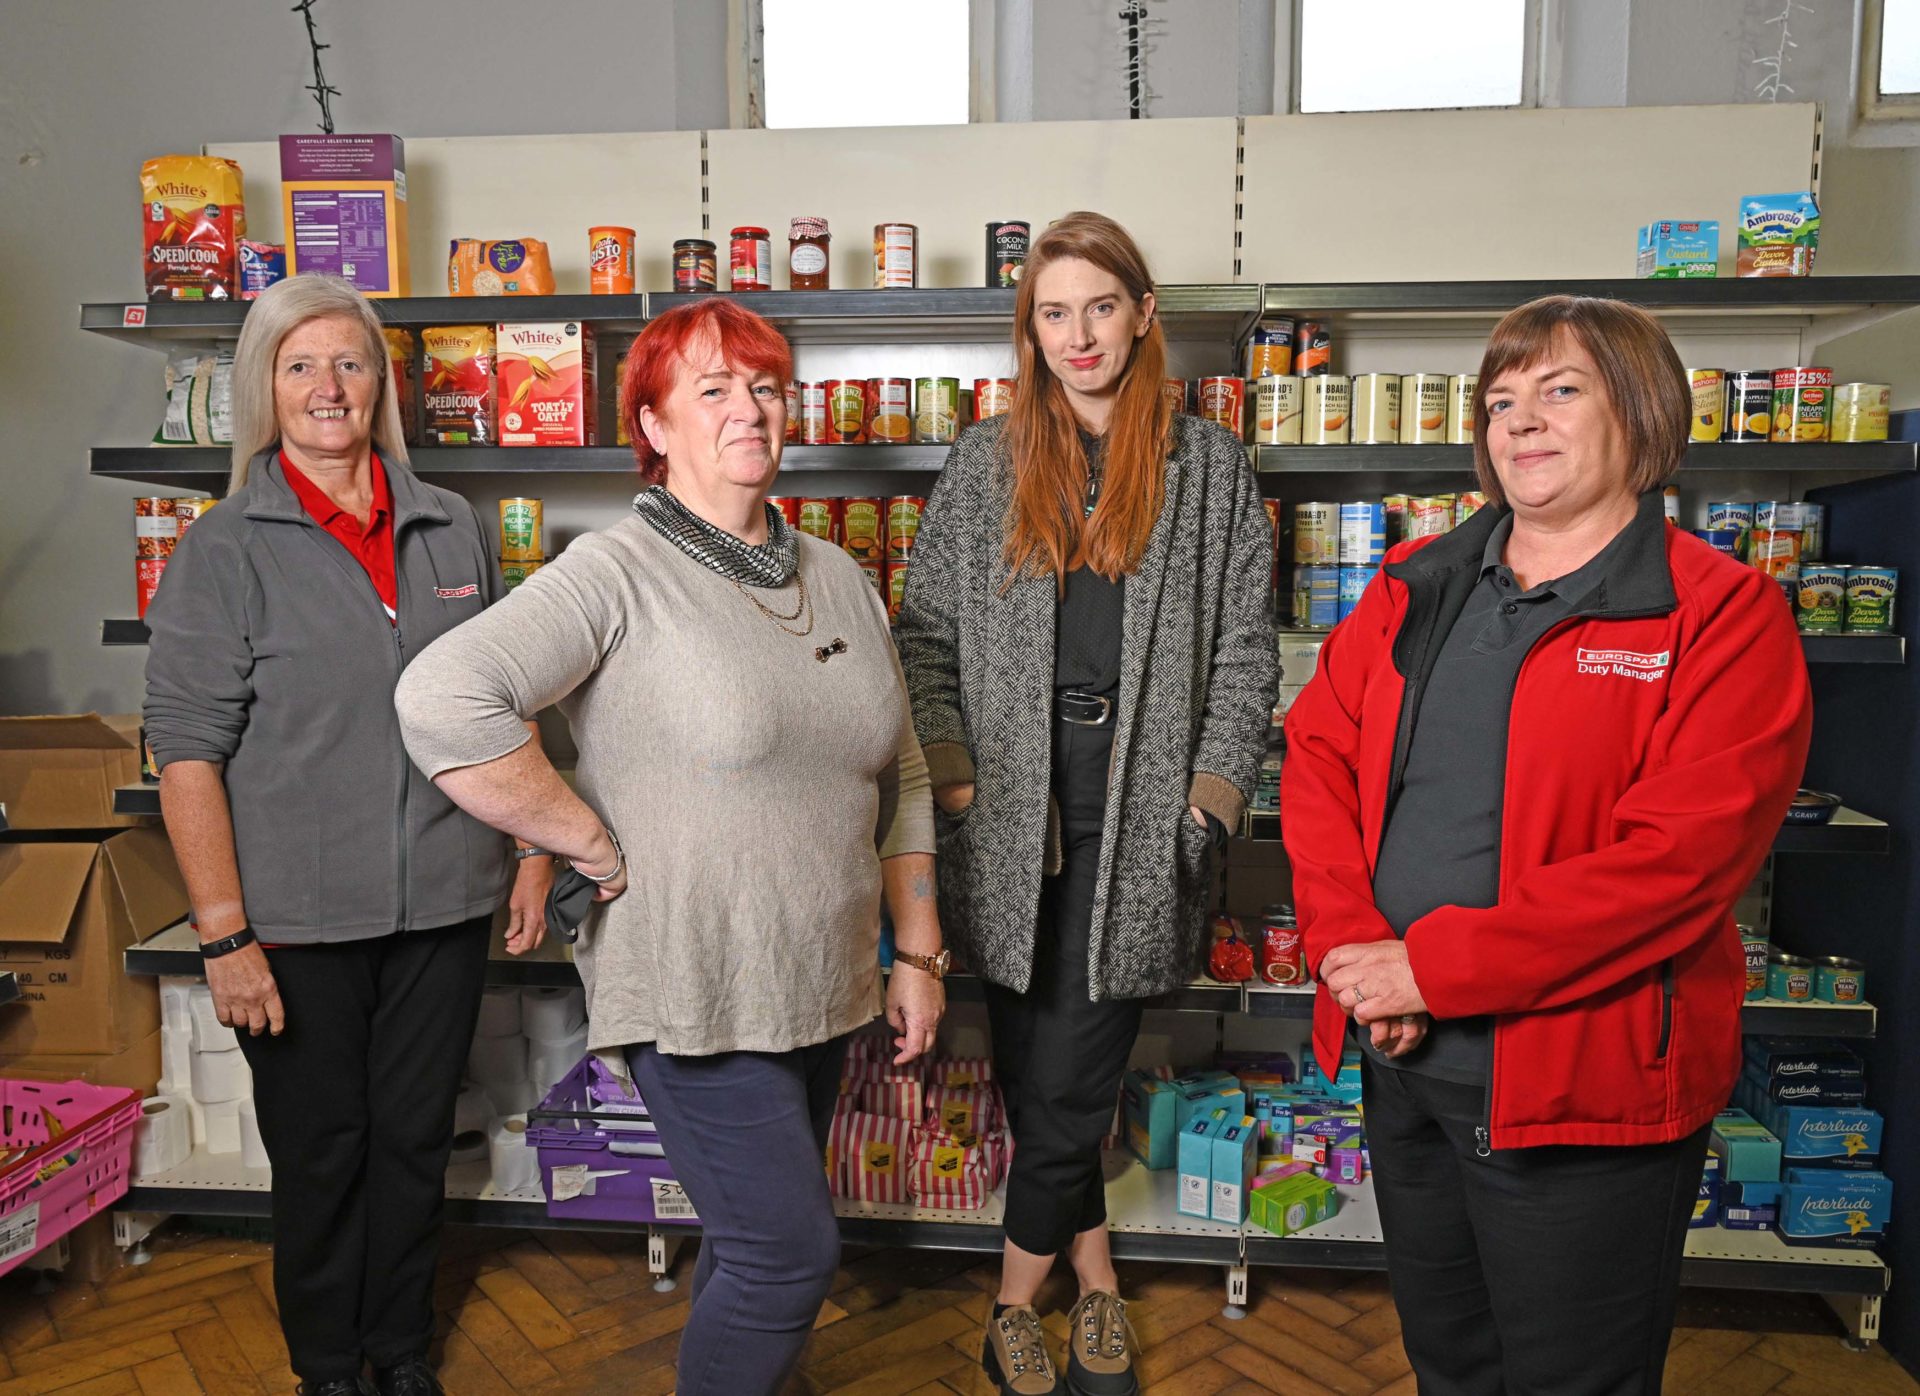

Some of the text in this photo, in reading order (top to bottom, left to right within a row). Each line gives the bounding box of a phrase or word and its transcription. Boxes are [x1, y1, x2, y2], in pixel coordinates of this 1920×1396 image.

[156, 182, 208, 198] White's
[1746, 211, 1801, 229] Ambrosia
[590, 243, 621, 266] BISTO
[1666, 248, 1709, 260] Custard
[1759, 251, 1786, 261] Devon
[168, 263, 189, 271] Porridge
[1753, 258, 1790, 268] Custard
[128, 311, 141, 321] £1
[429, 336, 472, 348] White's
[511, 330, 563, 346] White's
[1774, 373, 1795, 381] OVER
[1798, 371, 1827, 385] 25%
[835, 387, 858, 398] HEINZ
[1206, 384, 1231, 396] HEINZ
[531, 400, 575, 413] TOAT'LY
[836, 400, 859, 410] LENTIL
[537, 411, 568, 422] OATY
[506, 505, 529, 515] HEINZ
[802, 504, 825, 514] HEINZ
[850, 505, 873, 515] HEINZ
[891, 504, 915, 515] HEINZ
[503, 568, 525, 577] HEINZ
[1347, 579, 1365, 588] Rice
[1814, 607, 1836, 615] Devon
[1853, 607, 1881, 616] Devon
[1808, 614, 1839, 622] Custard
[1848, 614, 1885, 624] Custard
[1586, 653, 1658, 665] EUROSPAR
[1577, 663, 1665, 683] Duty Manager
[1794, 811, 1819, 819] GRAVY
[1744, 944, 1768, 954] HEINZ
[45, 950, 71, 960] KGS
[48, 972, 68, 983] CM
[1776, 1062, 1819, 1074] Interlude
[1778, 1085, 1821, 1097] Interlude
[1798, 1118, 1871, 1136] Interlude
[1800, 1195, 1873, 1215] Interlude
